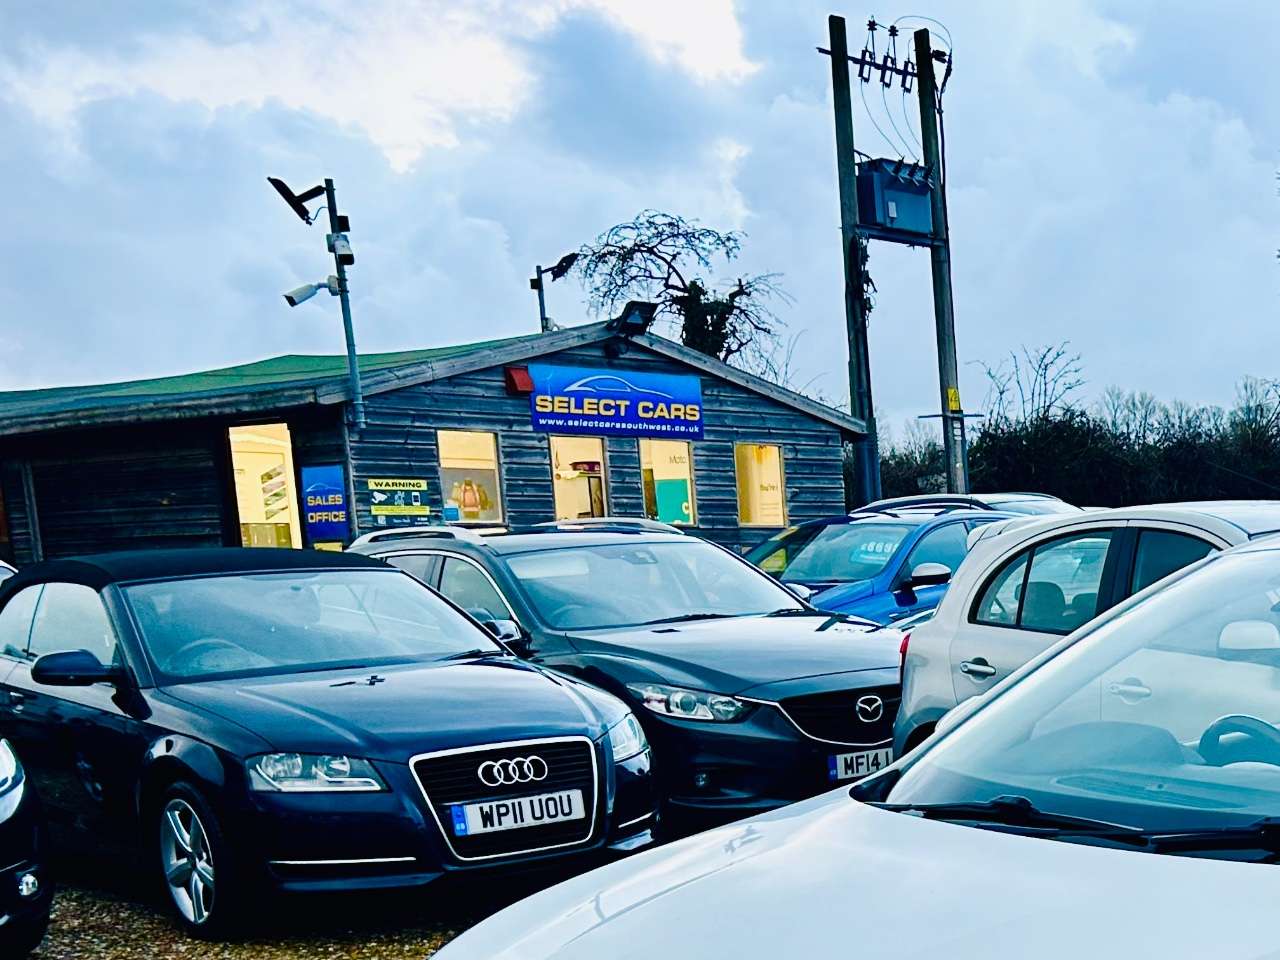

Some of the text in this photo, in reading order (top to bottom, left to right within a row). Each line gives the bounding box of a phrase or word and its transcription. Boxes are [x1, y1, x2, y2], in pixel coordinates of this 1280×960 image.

[535, 395, 700, 421] SELECT CARS
[539, 417, 700, 433] www.selectcarssouthwest.co.uk
[307, 494, 343, 507] SALES
[307, 511, 346, 523] OFFICE
[844, 752, 881, 775] MF14
[479, 794, 573, 829] WP11 UOU
